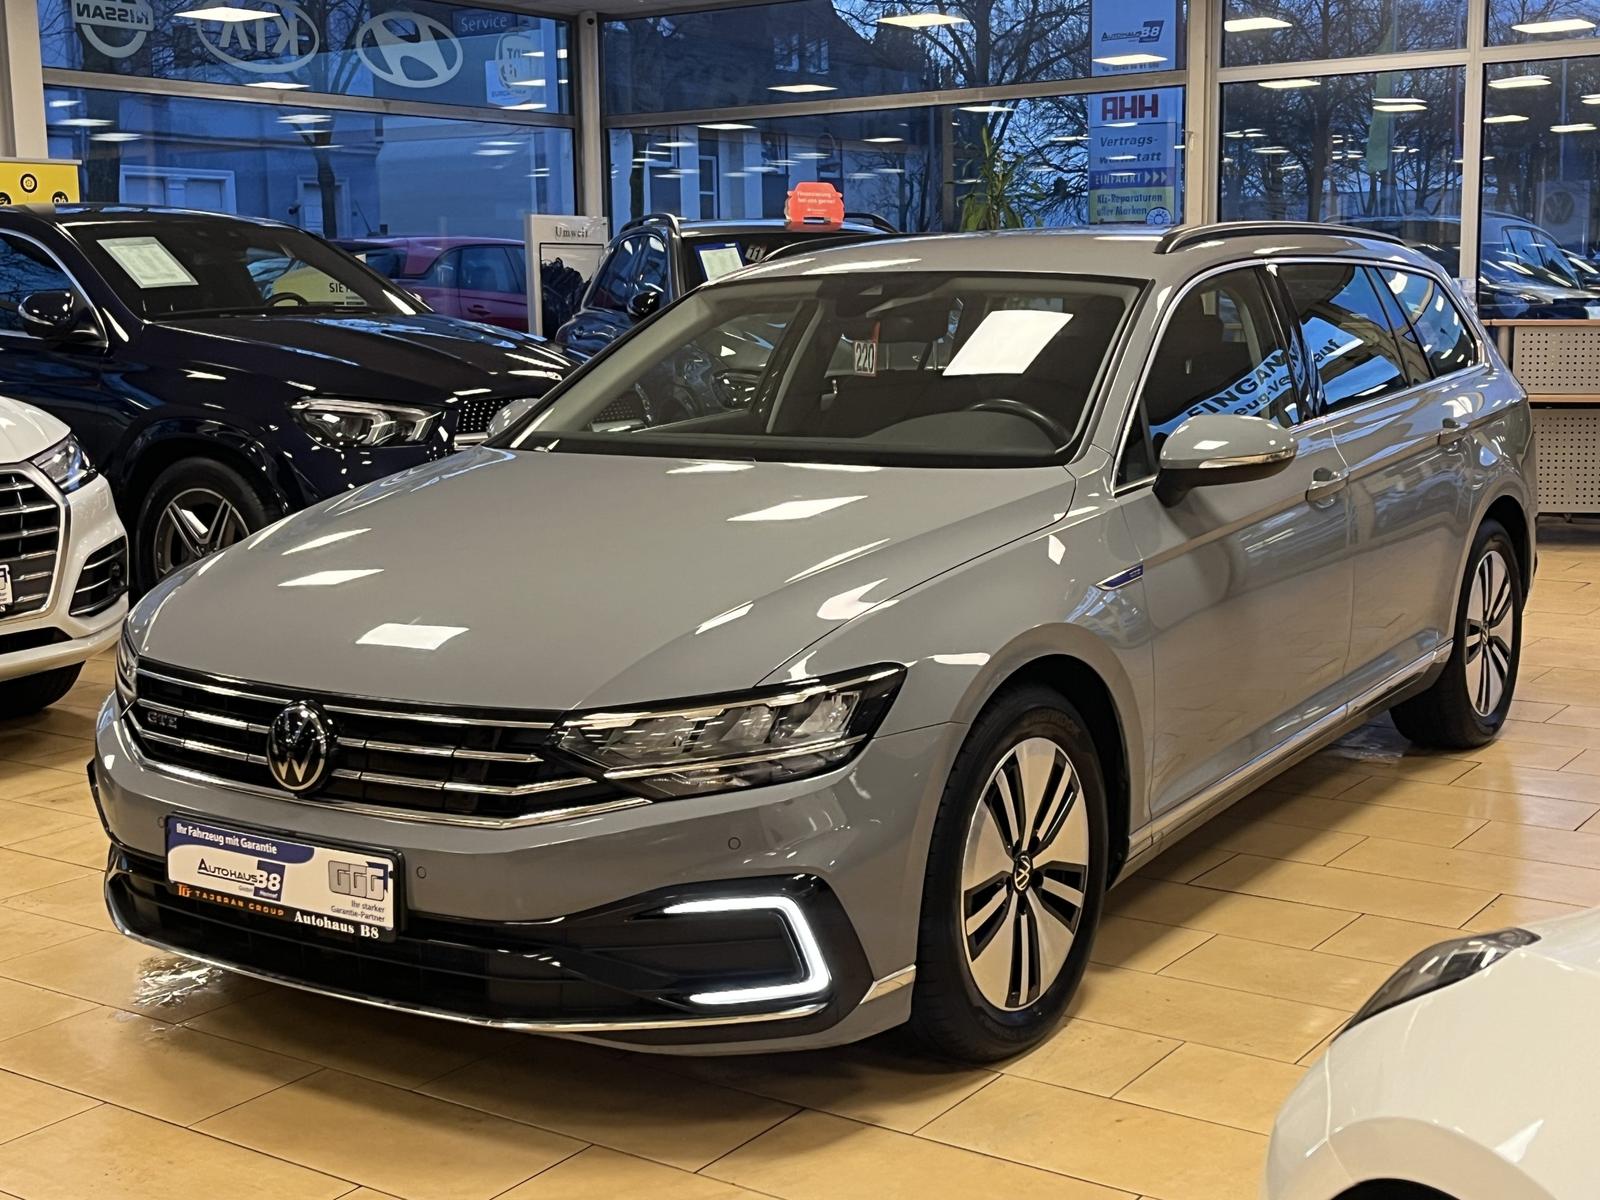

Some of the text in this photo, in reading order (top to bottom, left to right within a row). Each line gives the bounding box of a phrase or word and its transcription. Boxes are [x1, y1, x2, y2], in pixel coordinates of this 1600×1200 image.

[461, 14, 508, 32] Service
[1102, 94, 1159, 121] AHH
[1101, 136, 1159, 147] Vertrags-
[856, 343, 875, 373] 220
[147, 711, 178, 729] GTE
[176, 822, 278, 855] Ihr Fahrzeug mit Garantie
[248, 902, 285, 916] GROUP
[331, 904, 385, 922] Garantie-Partner
[362, 902, 385, 913] starker
[294, 911, 379, 939] Autohaus B8
